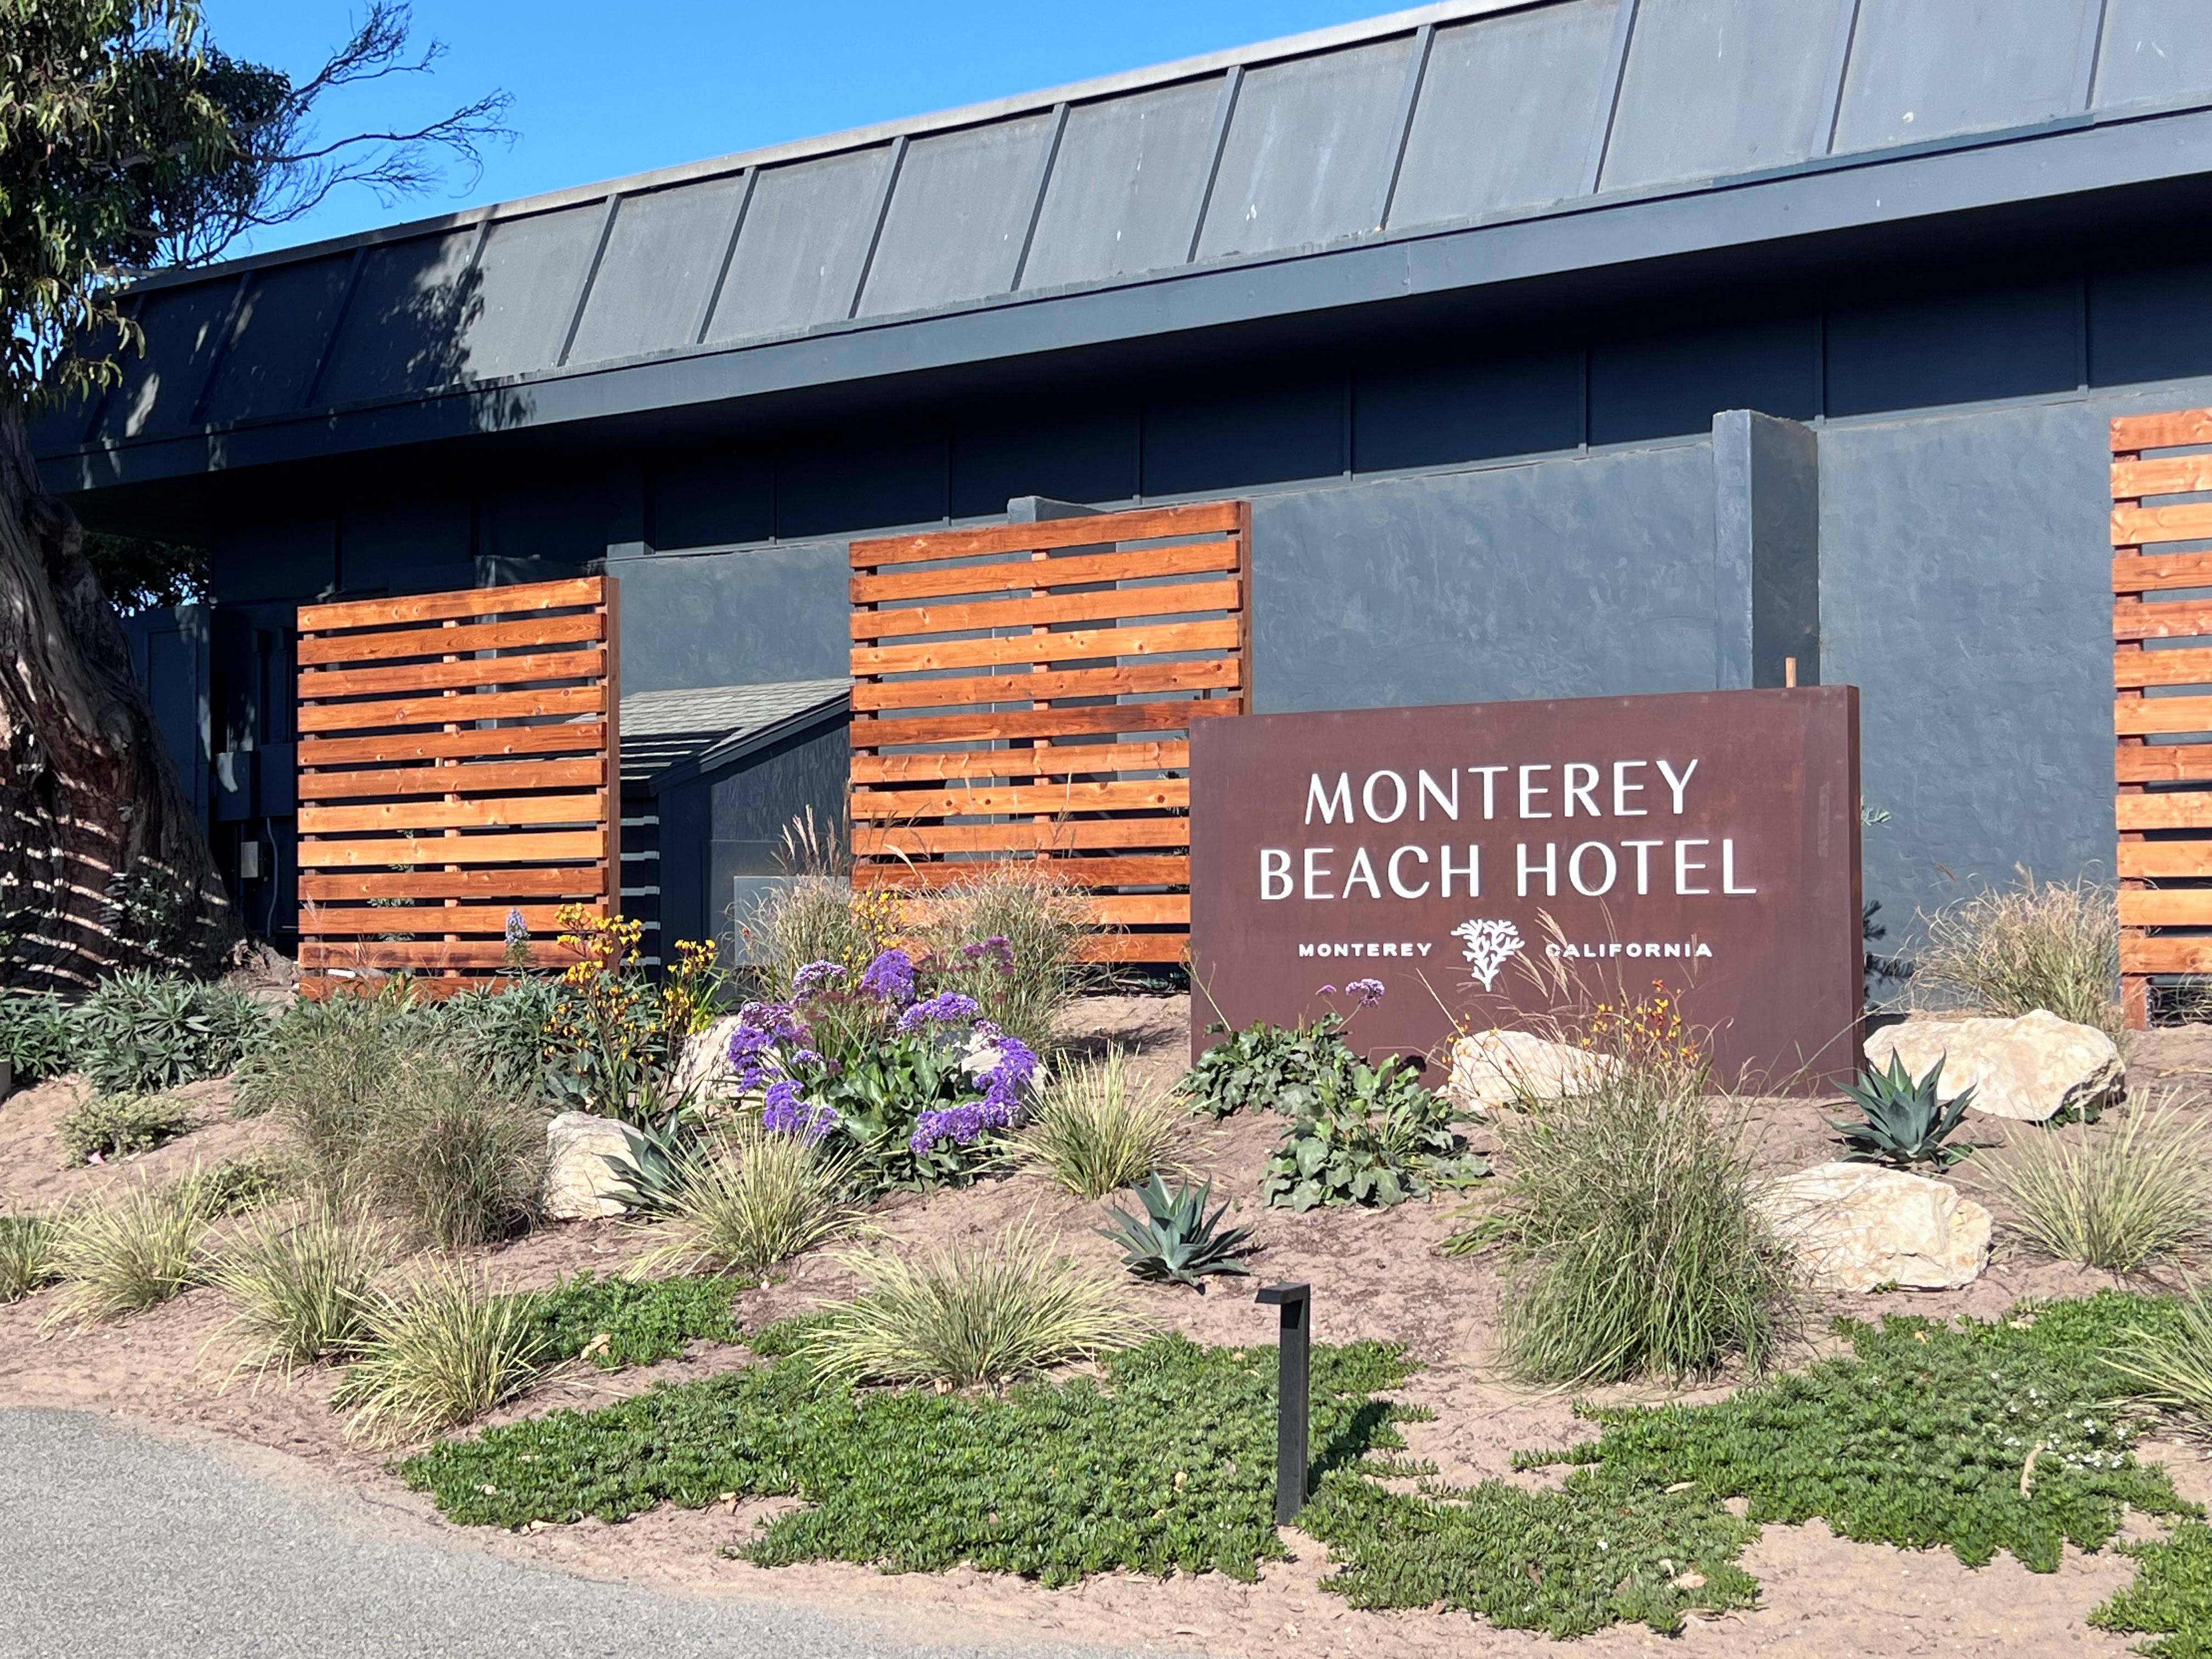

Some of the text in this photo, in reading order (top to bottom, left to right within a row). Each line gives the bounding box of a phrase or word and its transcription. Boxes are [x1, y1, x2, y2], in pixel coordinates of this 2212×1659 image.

[1305, 759, 1699, 825] MONTEREY
[1260, 838, 1757, 900] BEACH HOTEL
[1299, 943, 1713, 958] MONTEREY CALIFORNIA
